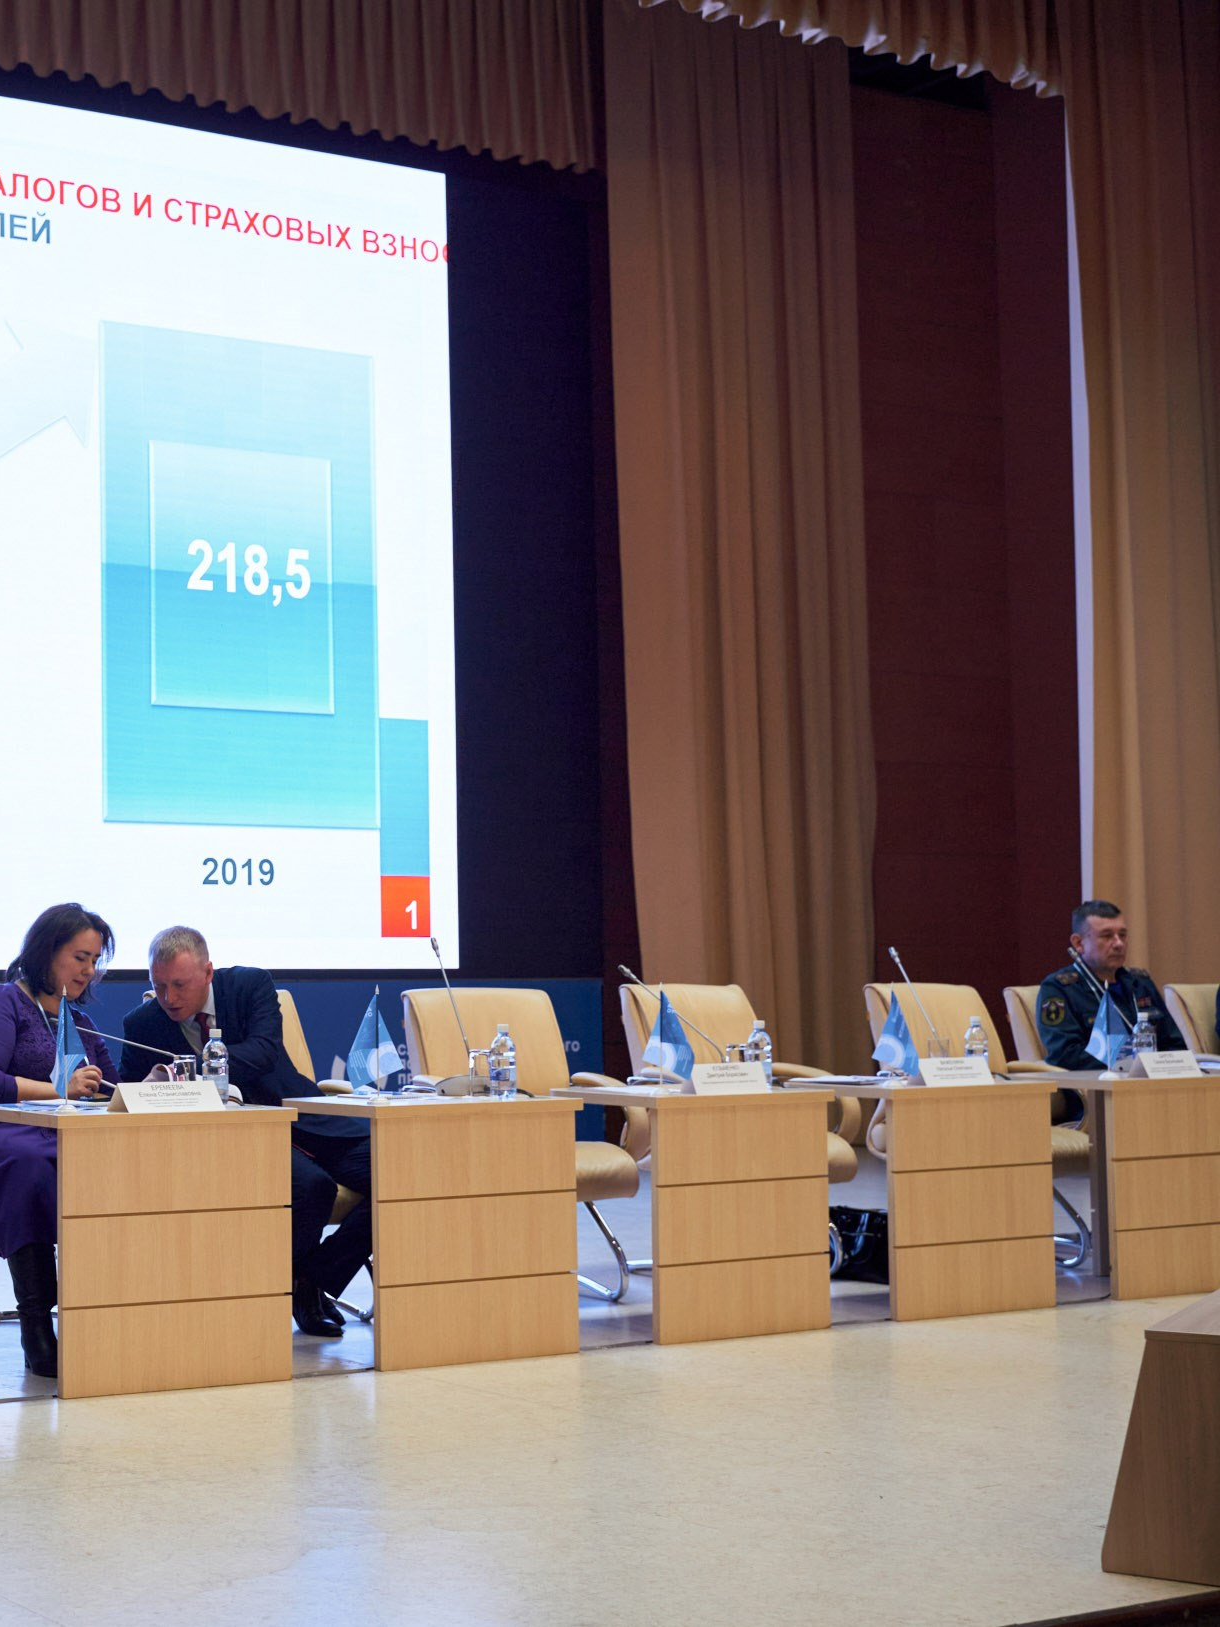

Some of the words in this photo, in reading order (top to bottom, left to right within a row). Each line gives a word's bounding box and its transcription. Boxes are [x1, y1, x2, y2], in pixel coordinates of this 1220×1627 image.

[133, 186, 153, 219] И
[163, 197, 352, 251] СТРАХОВЫХ
[362, 229, 448, 263] ВЗНО
[187, 539, 311, 606] 218,5
[202, 857, 275, 887] 2019
[405, 900, 418, 930] 1
